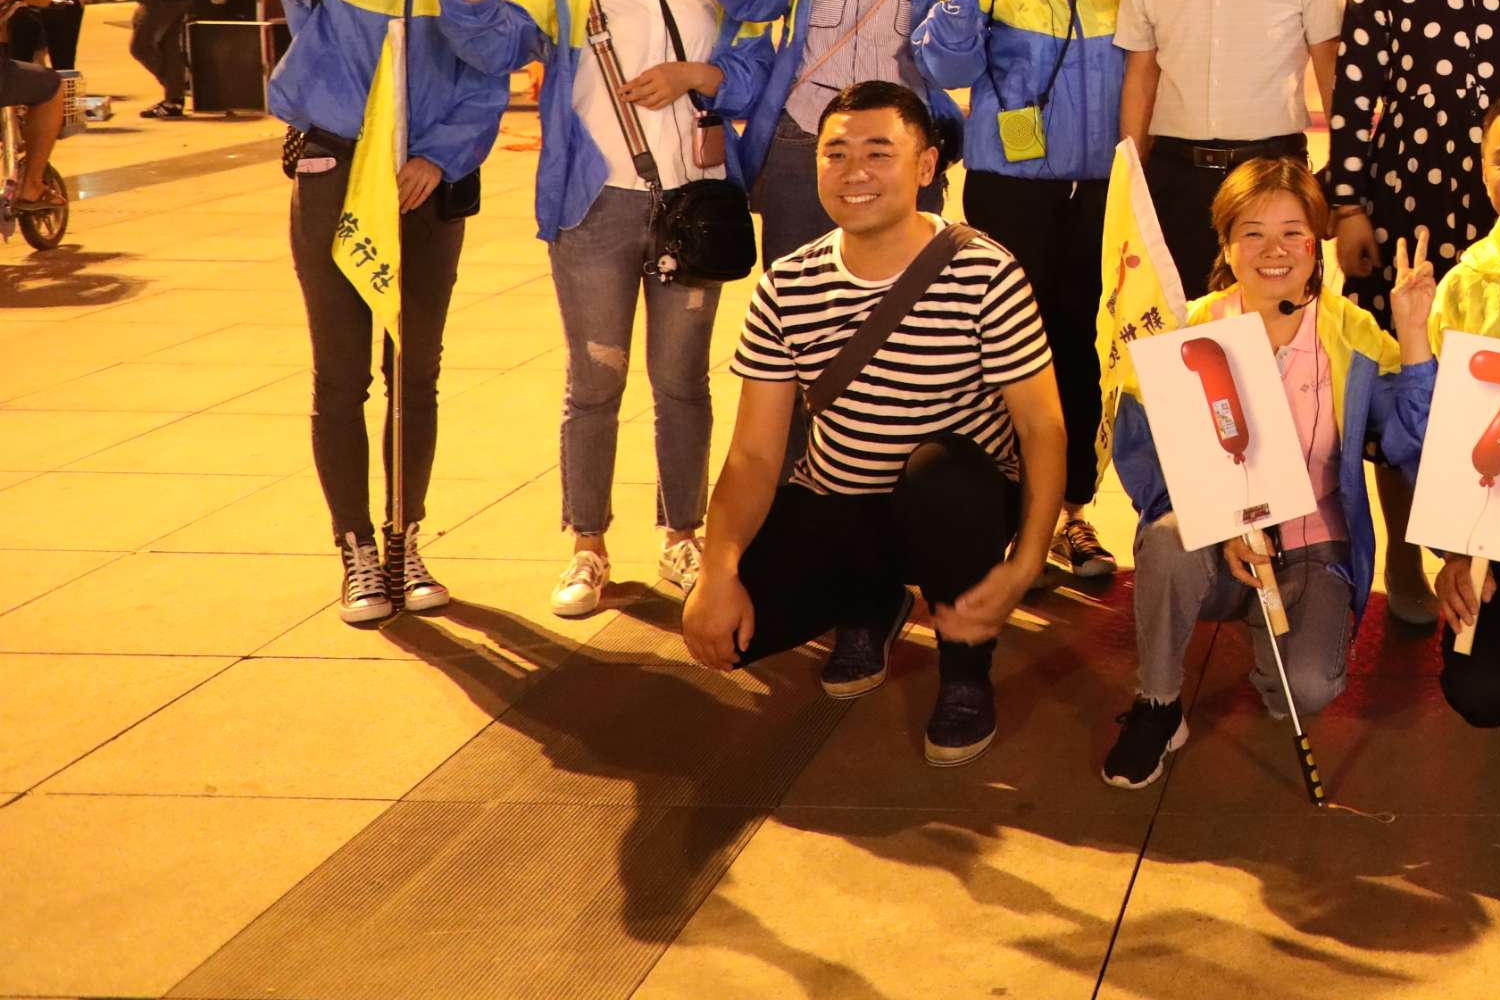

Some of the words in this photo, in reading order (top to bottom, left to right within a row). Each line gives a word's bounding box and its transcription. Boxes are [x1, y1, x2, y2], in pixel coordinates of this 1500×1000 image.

[338, 211, 395, 294] 旅行社
[1180, 337, 1250, 456] 1
